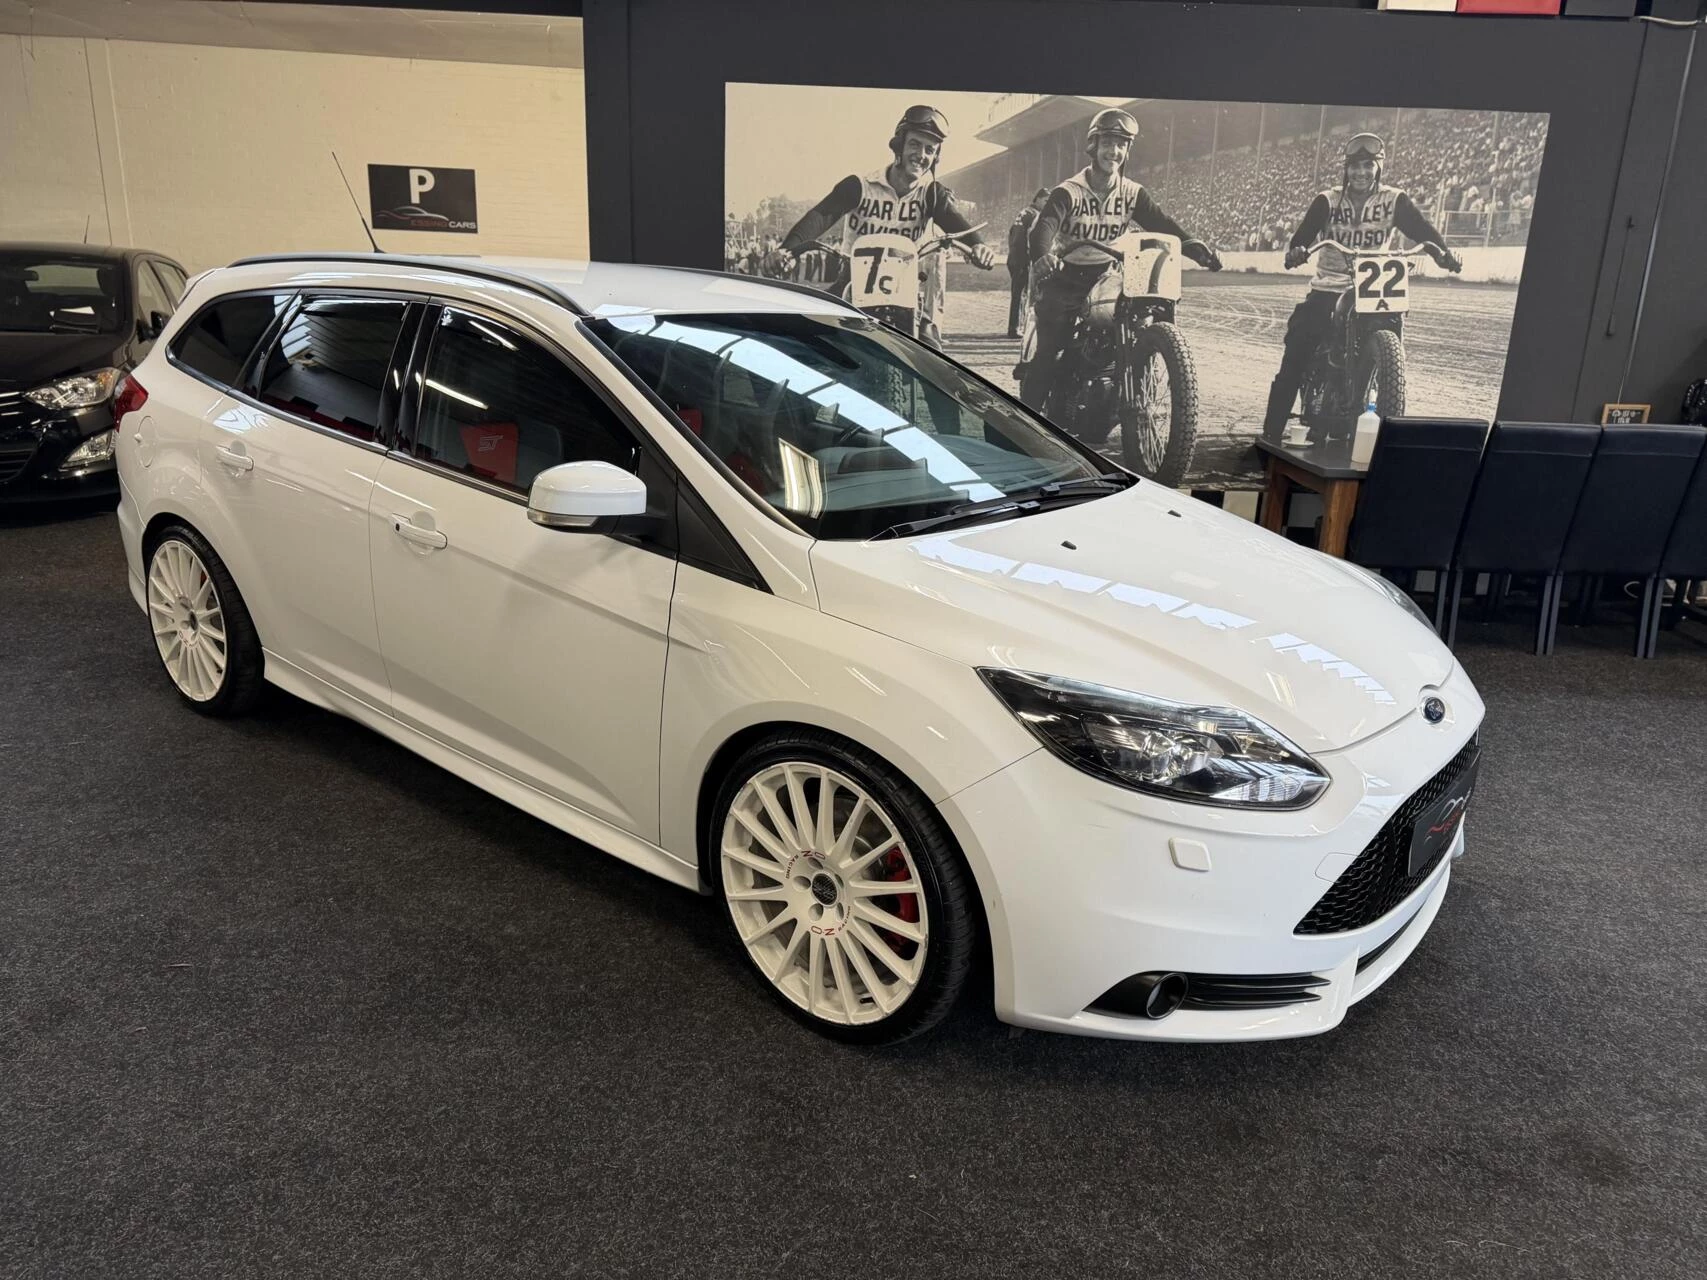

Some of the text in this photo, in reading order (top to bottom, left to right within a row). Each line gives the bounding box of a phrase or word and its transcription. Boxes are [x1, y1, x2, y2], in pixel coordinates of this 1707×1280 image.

[409, 168, 435, 204] P
[448, 220, 477, 230] CARS
[1061, 222, 1130, 241] DAVIDSO
[1140, 239, 1171, 294] 7
[1358, 261, 1406, 298] 22
[1376, 299, 1389, 311] A
